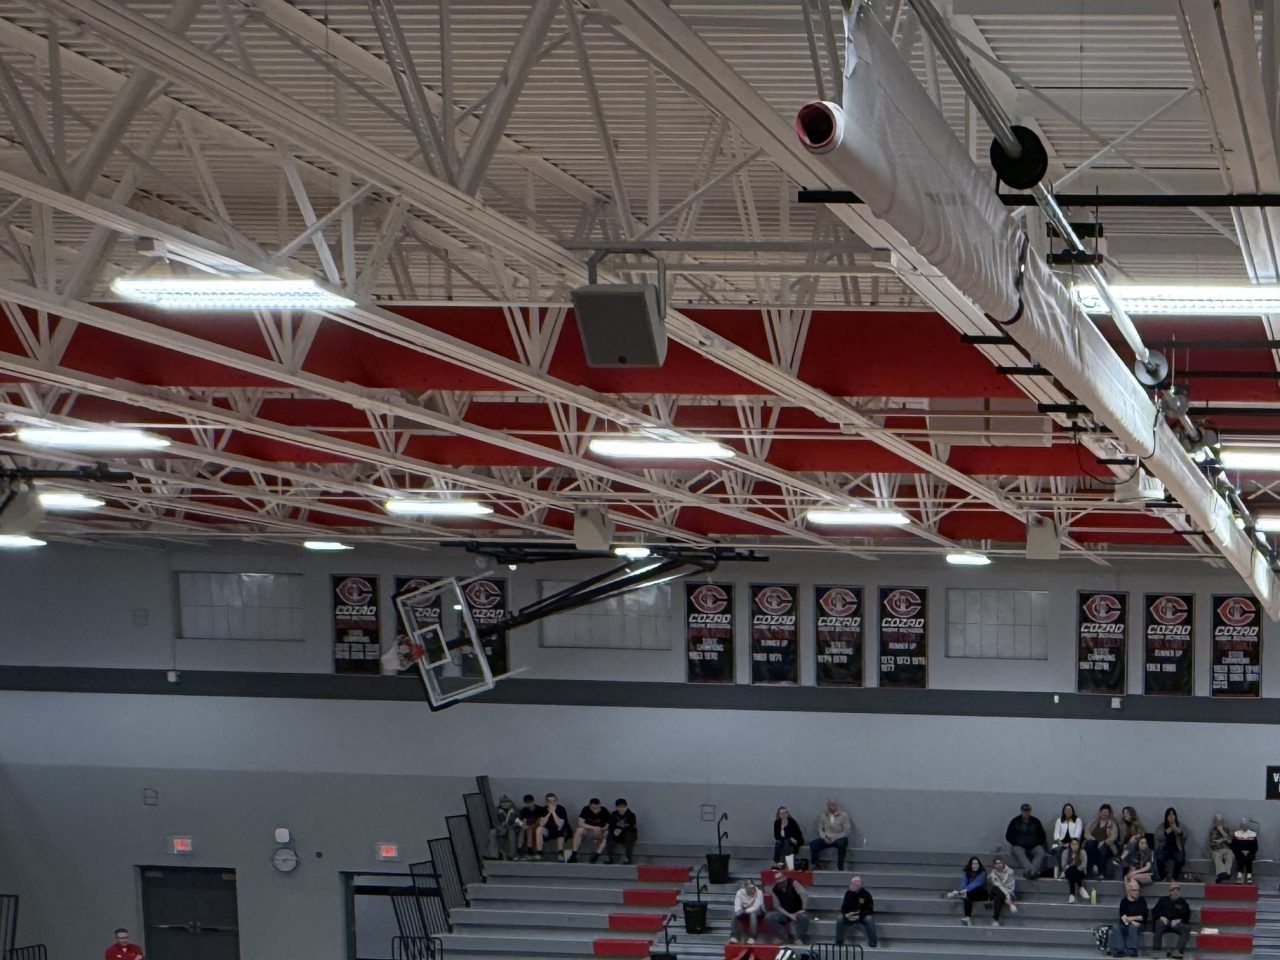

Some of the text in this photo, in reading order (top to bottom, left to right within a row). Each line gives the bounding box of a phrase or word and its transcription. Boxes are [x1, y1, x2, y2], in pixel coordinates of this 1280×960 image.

[689, 614, 731, 623] COZAD
[753, 616, 795, 624] COZAD
[818, 617, 861, 626] COZAD
[882, 618, 924, 627] COZAD
[1080, 624, 1124, 633] COZAD
[1147, 625, 1191, 634] COZAD
[1215, 626, 1259, 636] COZAD
